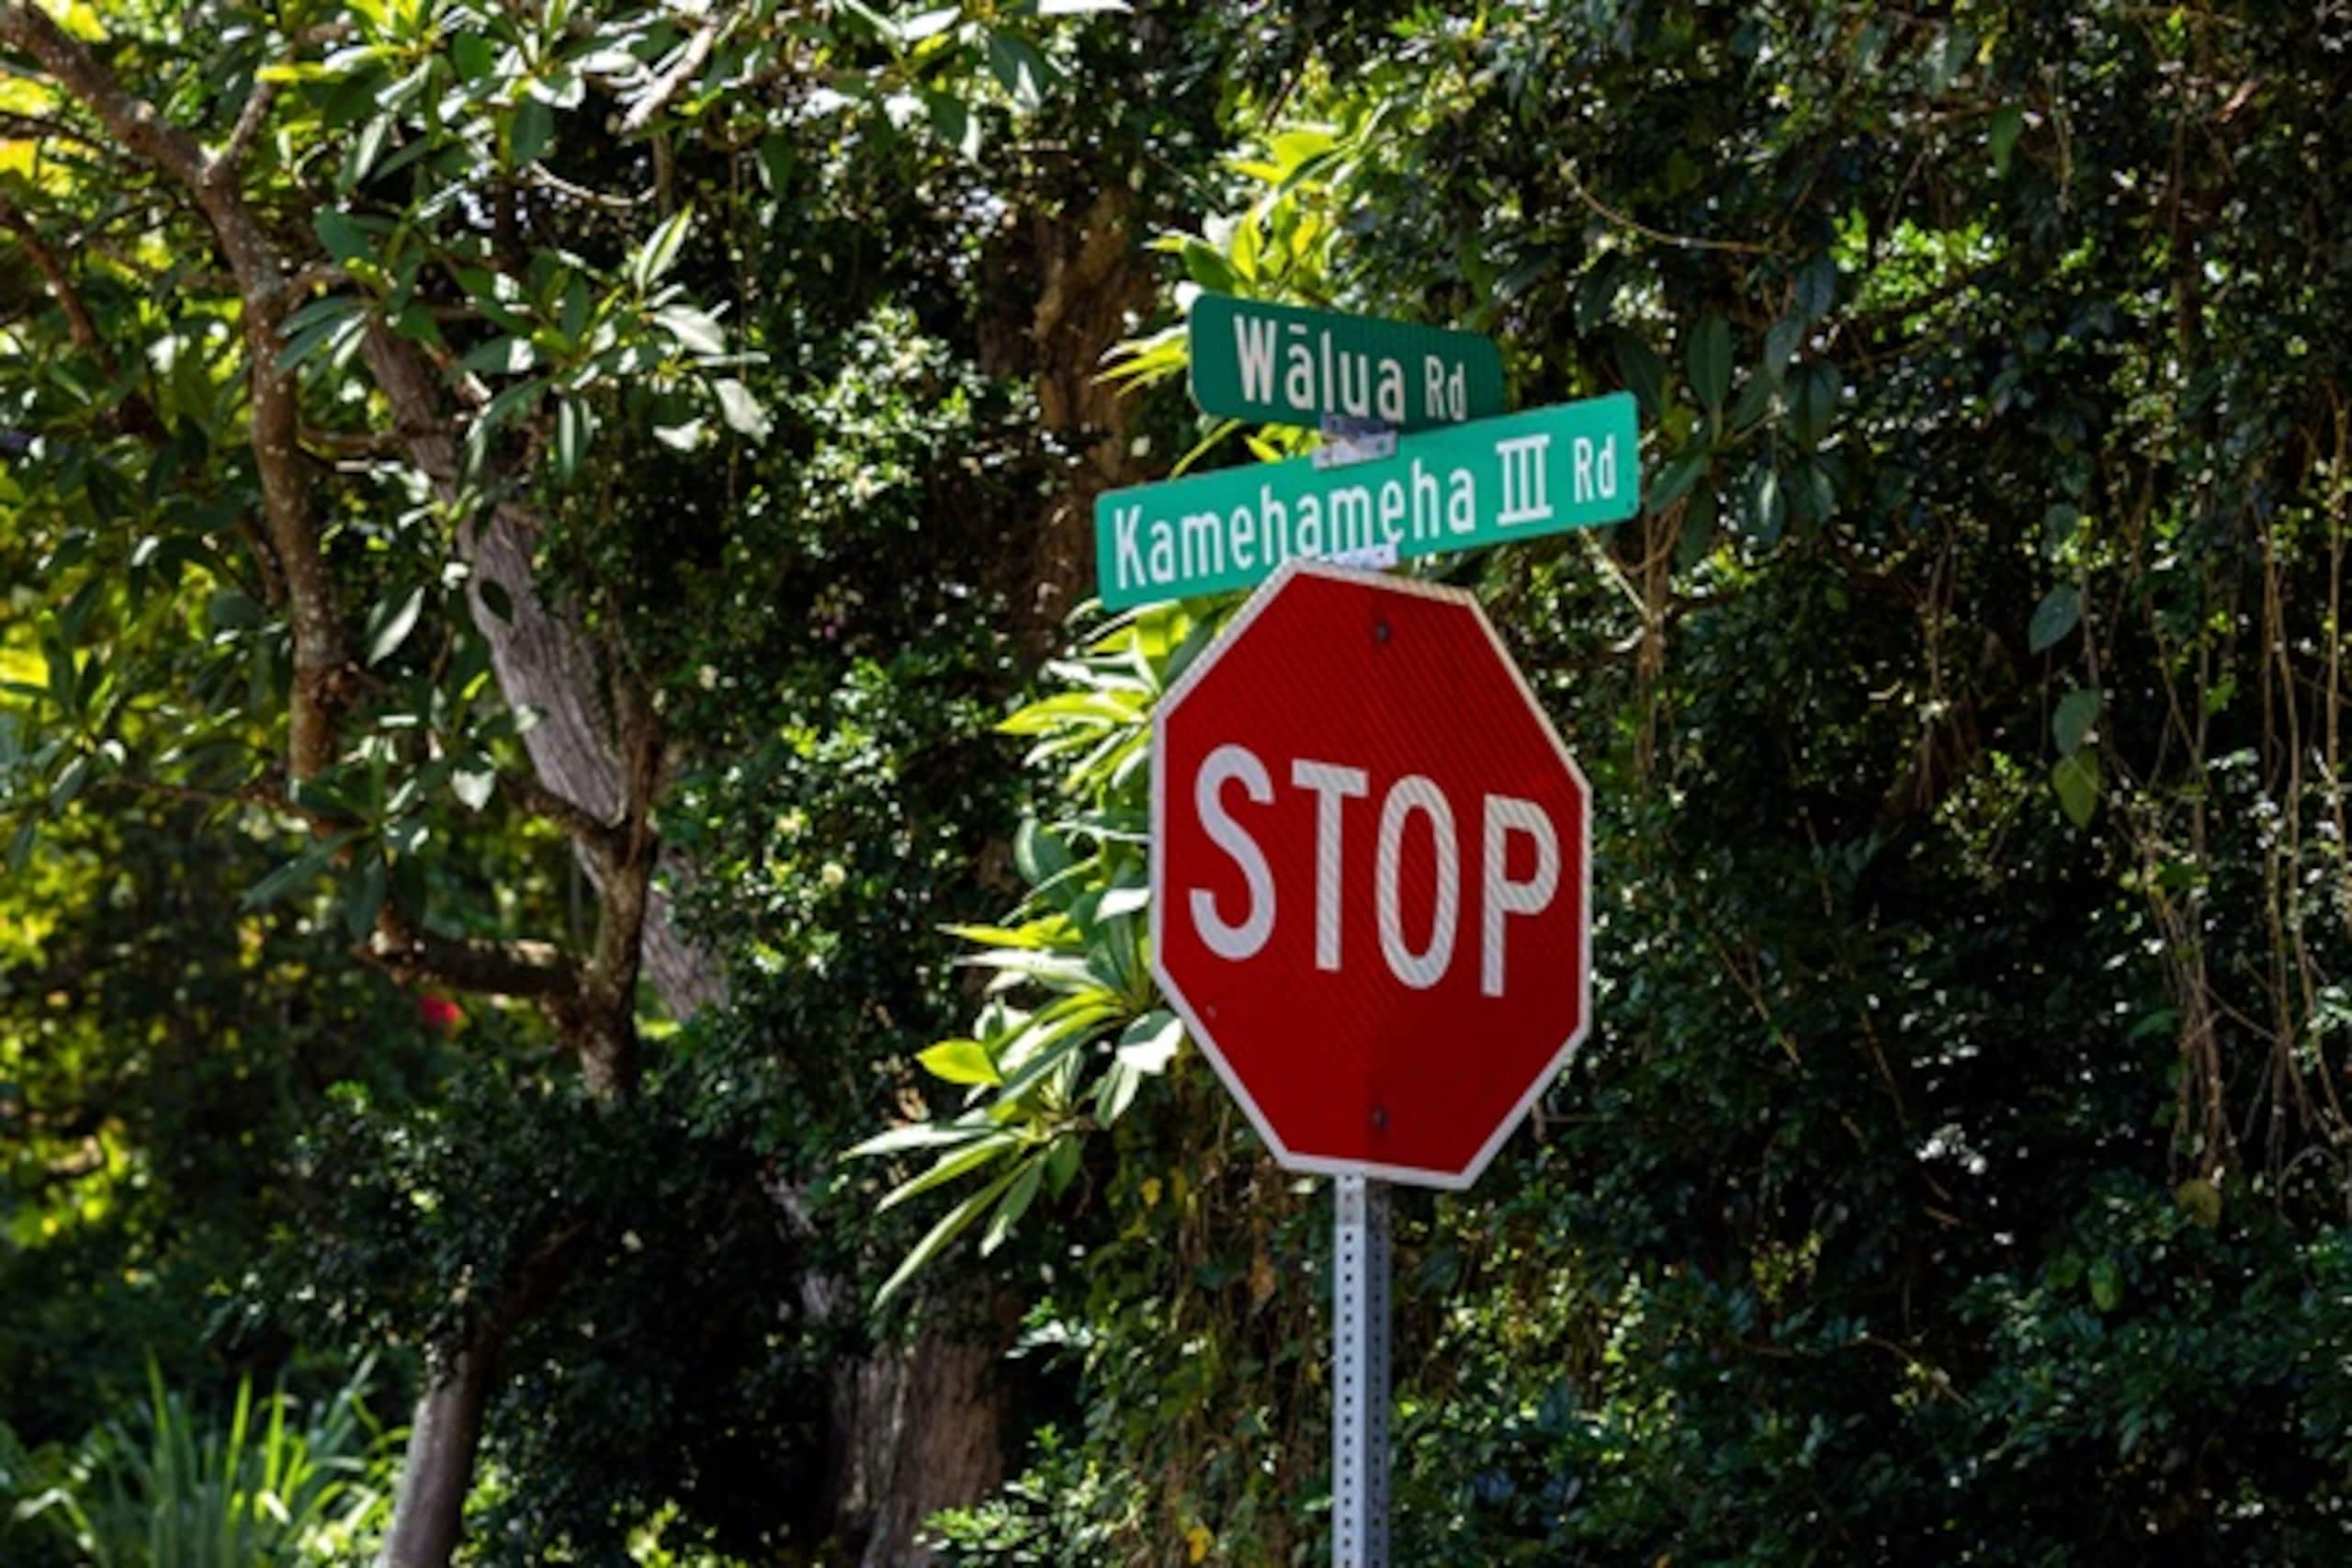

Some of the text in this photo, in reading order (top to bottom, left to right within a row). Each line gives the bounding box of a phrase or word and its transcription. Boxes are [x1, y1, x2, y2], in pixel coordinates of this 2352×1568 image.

[1233, 314, 1466, 423] Wālua Rd
[1113, 434, 1617, 590] Kamehameha III Rd
[1189, 744, 1561, 998] STOP
